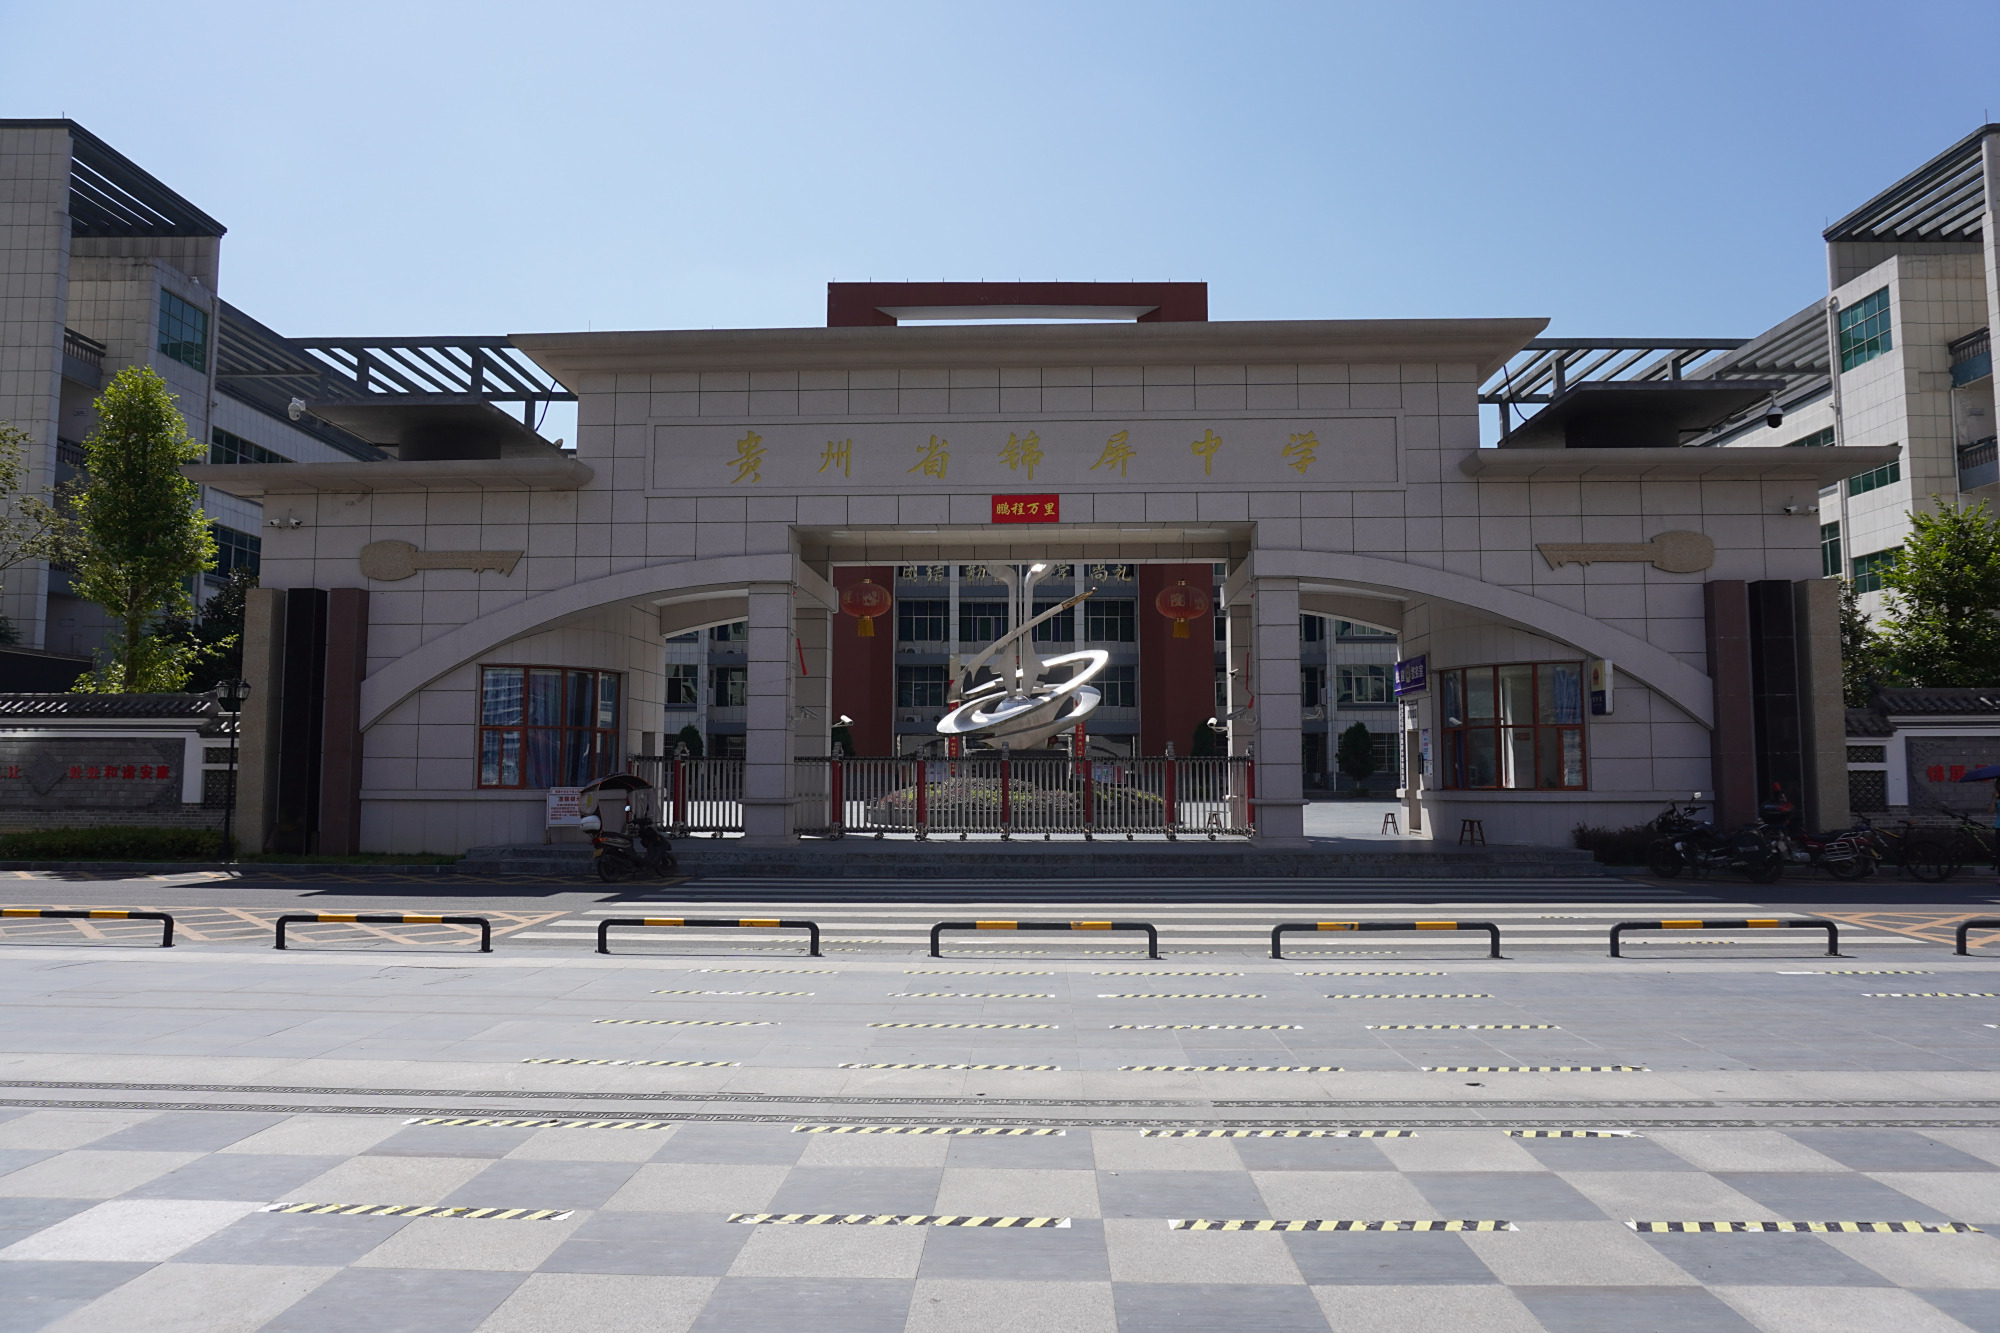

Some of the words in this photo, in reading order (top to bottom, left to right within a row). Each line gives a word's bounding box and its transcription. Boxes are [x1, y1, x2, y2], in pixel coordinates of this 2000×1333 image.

[727, 429, 1319, 484] 贵州省锦屏中学
[996, 502, 1056, 516] 鹏程万里
[69, 764, 169, 780] 处处和谐安康
